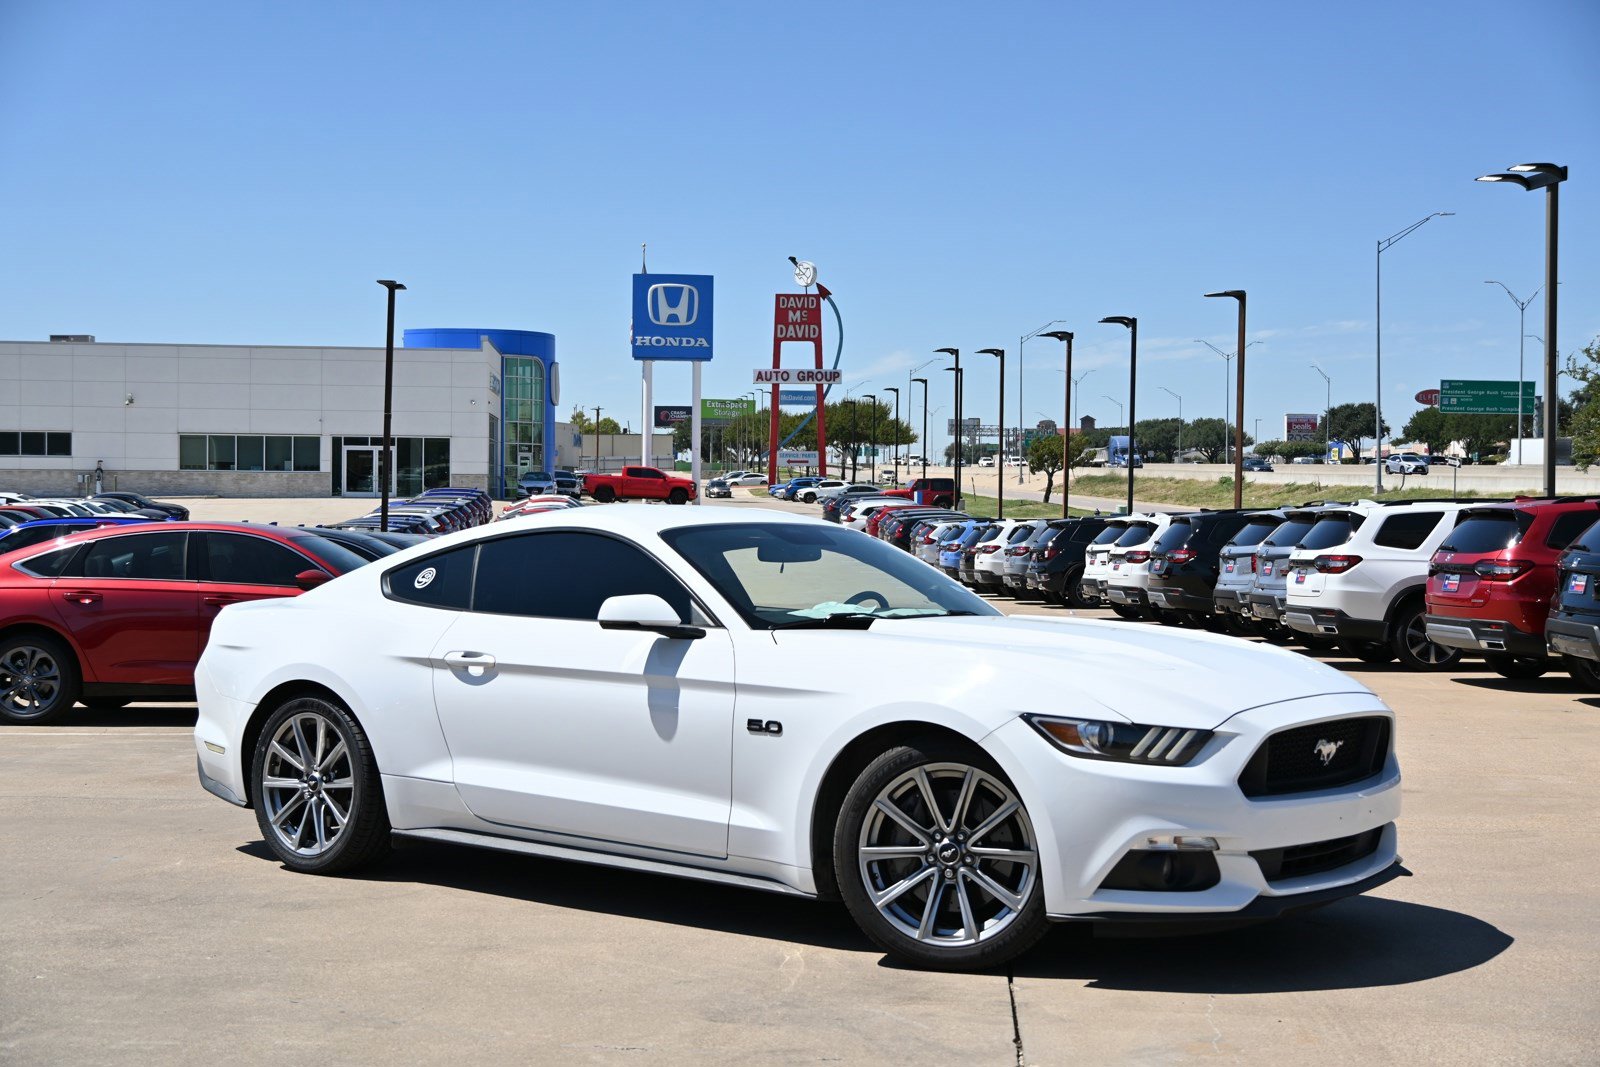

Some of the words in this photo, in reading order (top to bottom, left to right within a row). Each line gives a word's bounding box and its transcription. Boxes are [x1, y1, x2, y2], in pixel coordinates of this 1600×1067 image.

[780, 297, 816, 309] DAVID
[777, 324, 819, 338] DAVID
[635, 336, 710, 347] HONDA
[756, 371, 790, 382] AUTO
[797, 371, 840, 383] GROUP
[747, 719, 783, 735] 5.0
